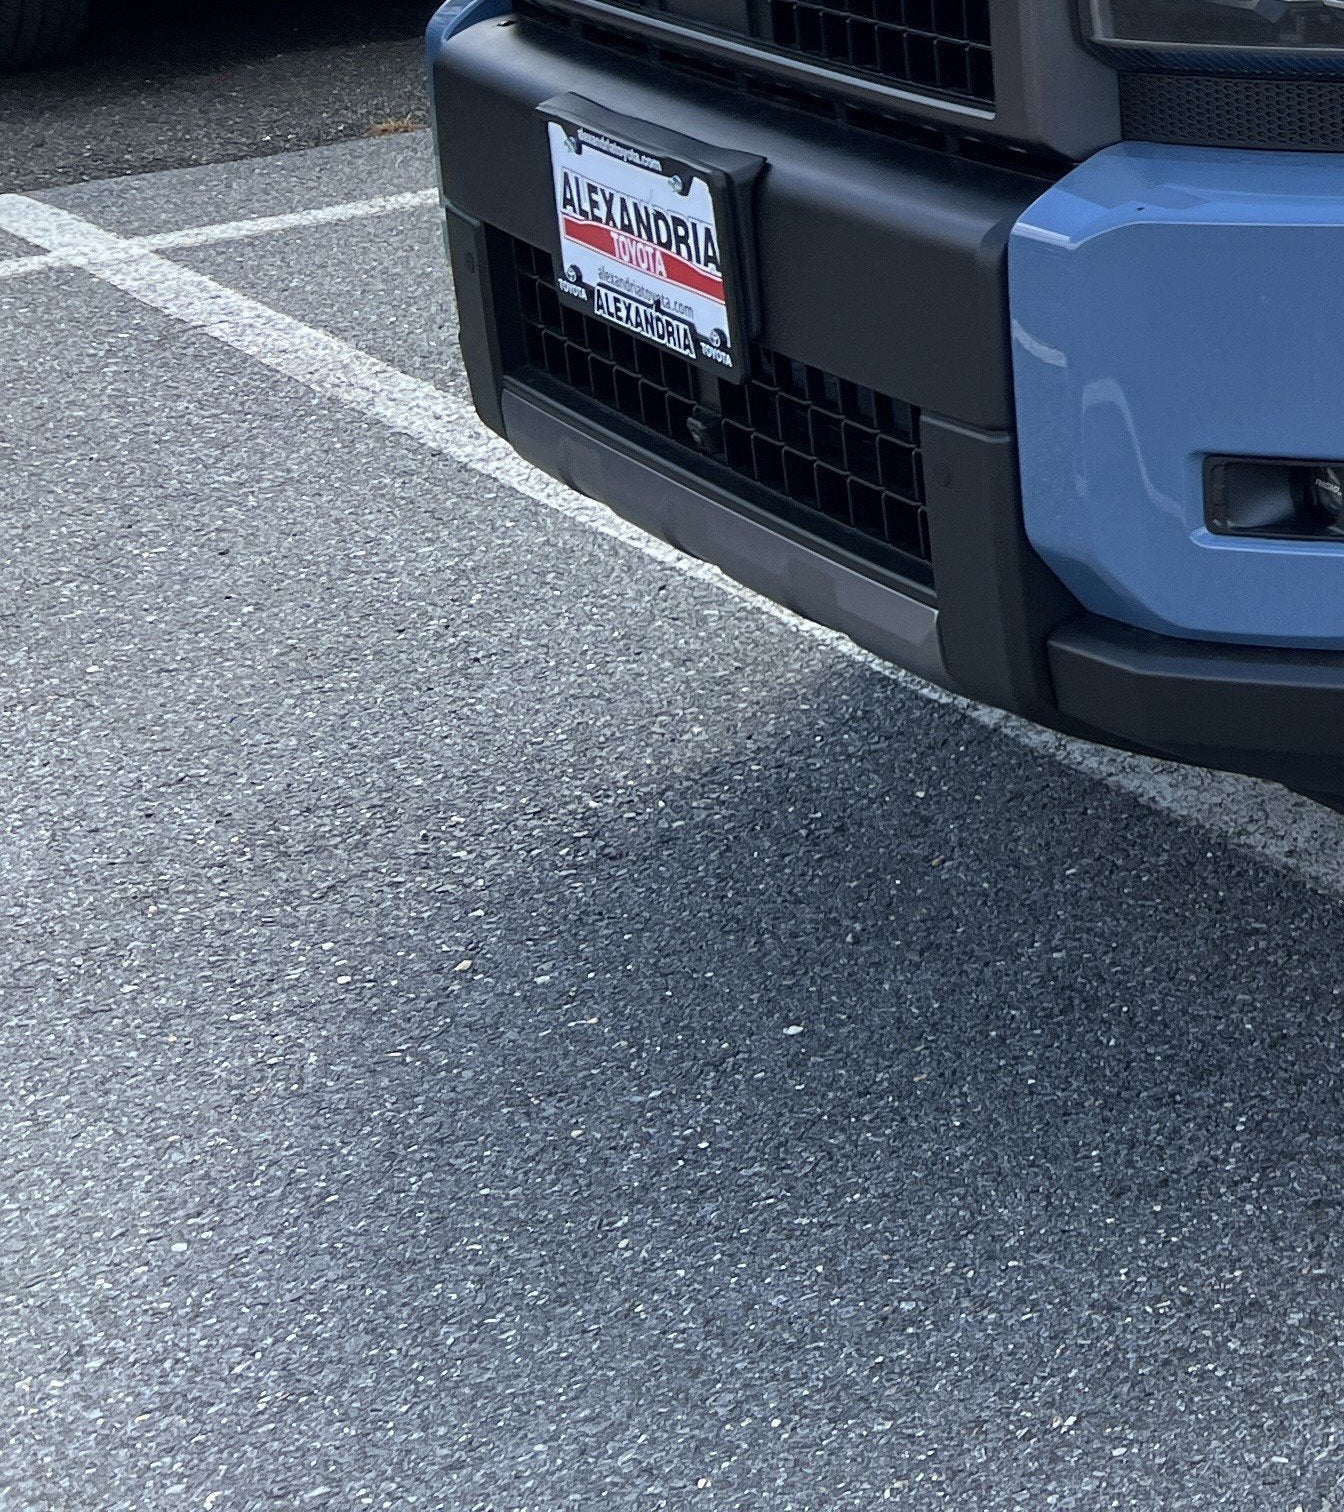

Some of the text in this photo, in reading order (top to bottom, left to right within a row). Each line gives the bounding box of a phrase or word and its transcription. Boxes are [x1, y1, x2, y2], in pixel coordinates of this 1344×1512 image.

[562, 171, 721, 268] ALEXANDRIA
[611, 231, 668, 278] TOYOTA
[558, 277, 588, 301] TOYOTA
[596, 288, 696, 357] ALEXANDRIA
[699, 341, 733, 367] TOYOTA
